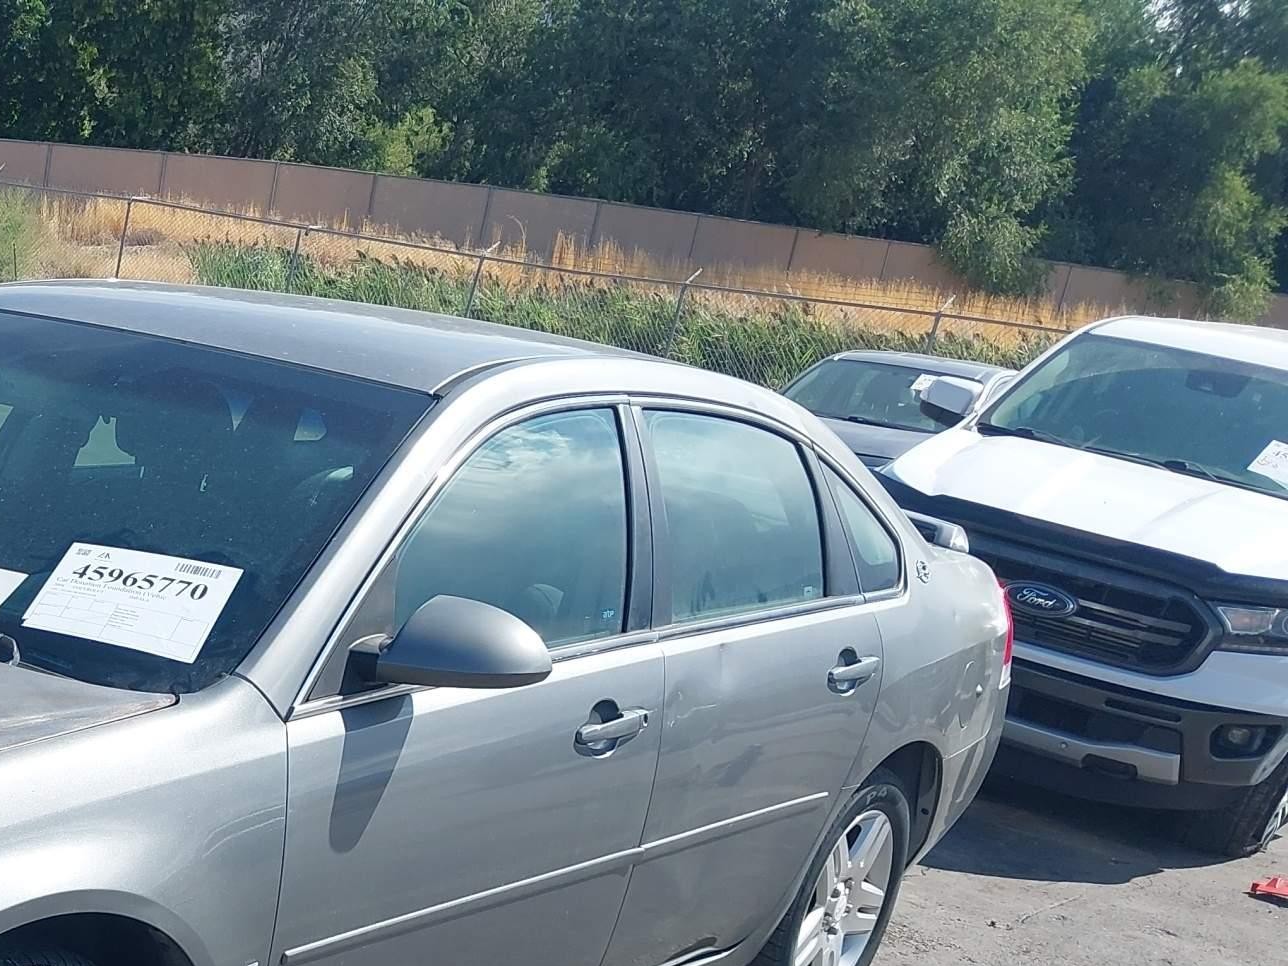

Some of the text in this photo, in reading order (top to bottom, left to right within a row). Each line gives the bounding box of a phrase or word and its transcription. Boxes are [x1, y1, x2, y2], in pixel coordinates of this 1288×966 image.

[72, 563, 209, 601] 45965770
[103, 583, 142, 597] Foundation
[1016, 588, 1057, 609] Ford
